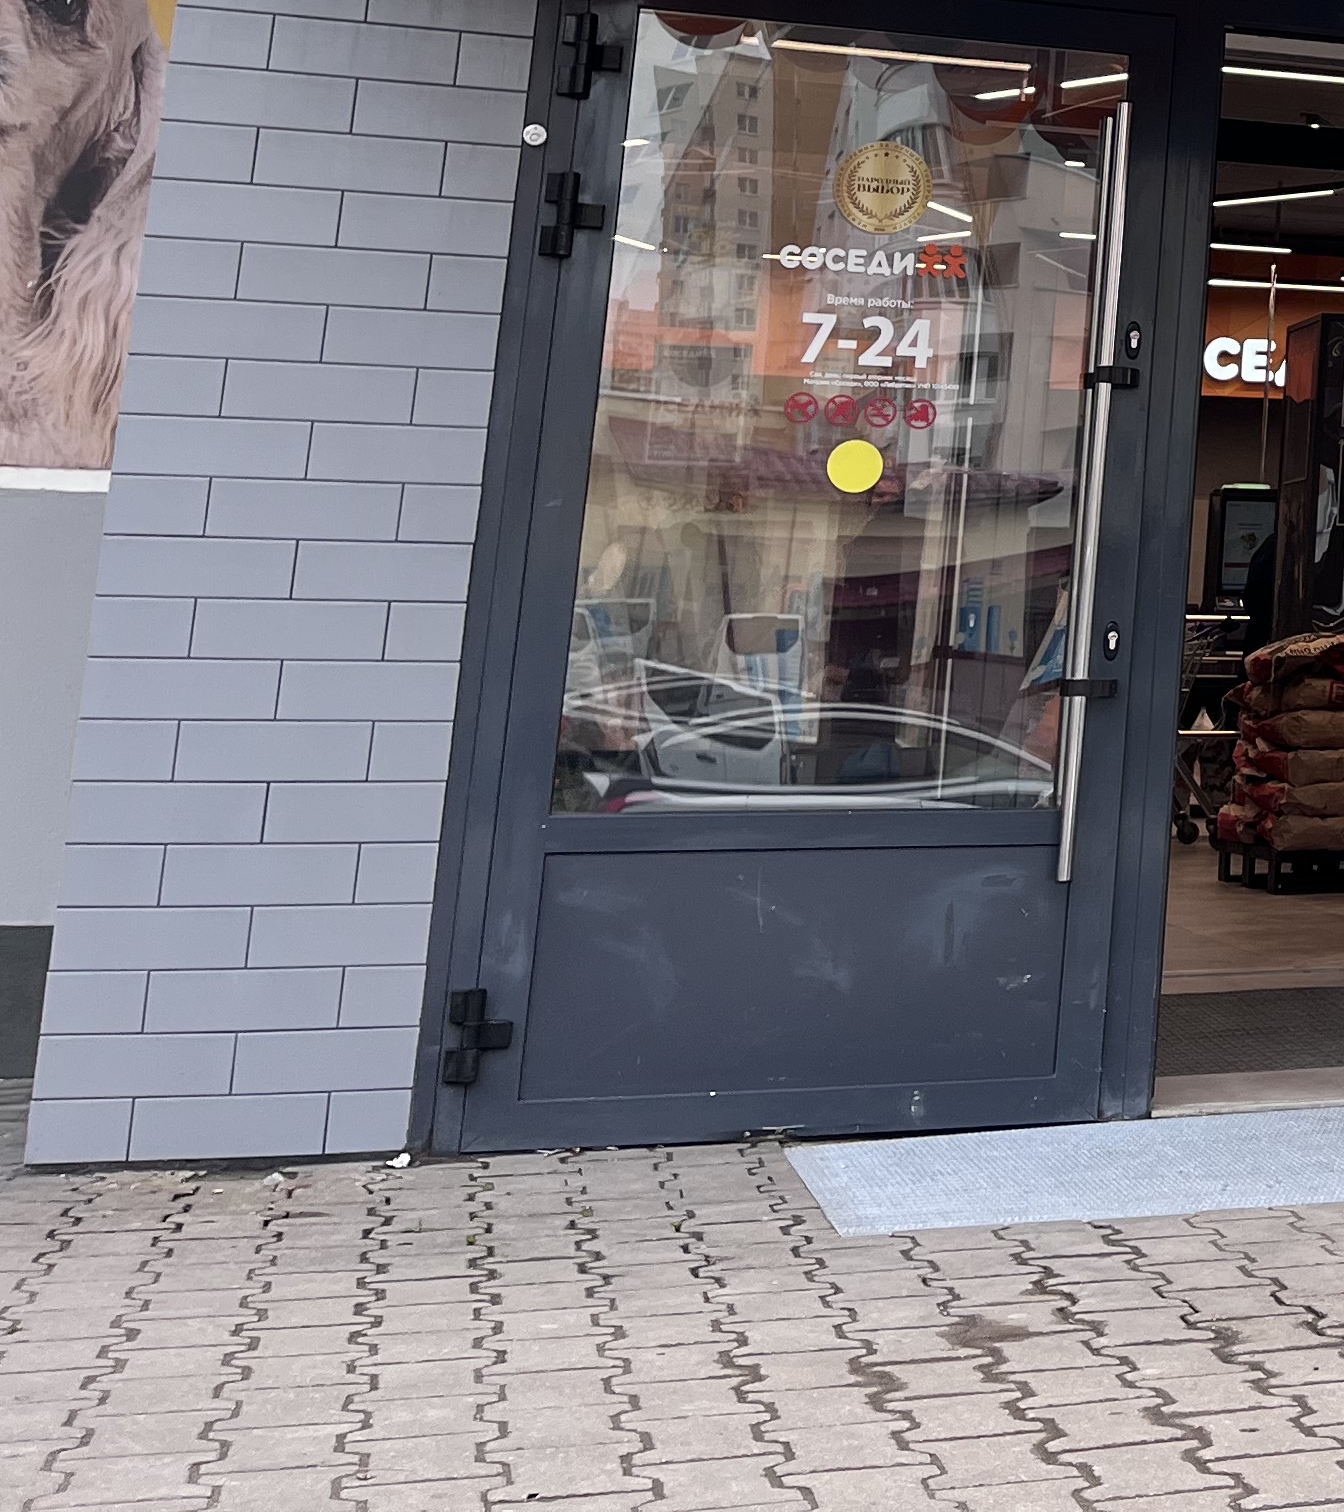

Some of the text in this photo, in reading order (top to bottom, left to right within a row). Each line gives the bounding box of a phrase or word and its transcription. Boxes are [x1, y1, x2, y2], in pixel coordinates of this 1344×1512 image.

[779, 244, 915, 277] СОСЕДИ
[826, 293, 914, 309] Время работы:
[800, 312, 933, 369] 7-24
